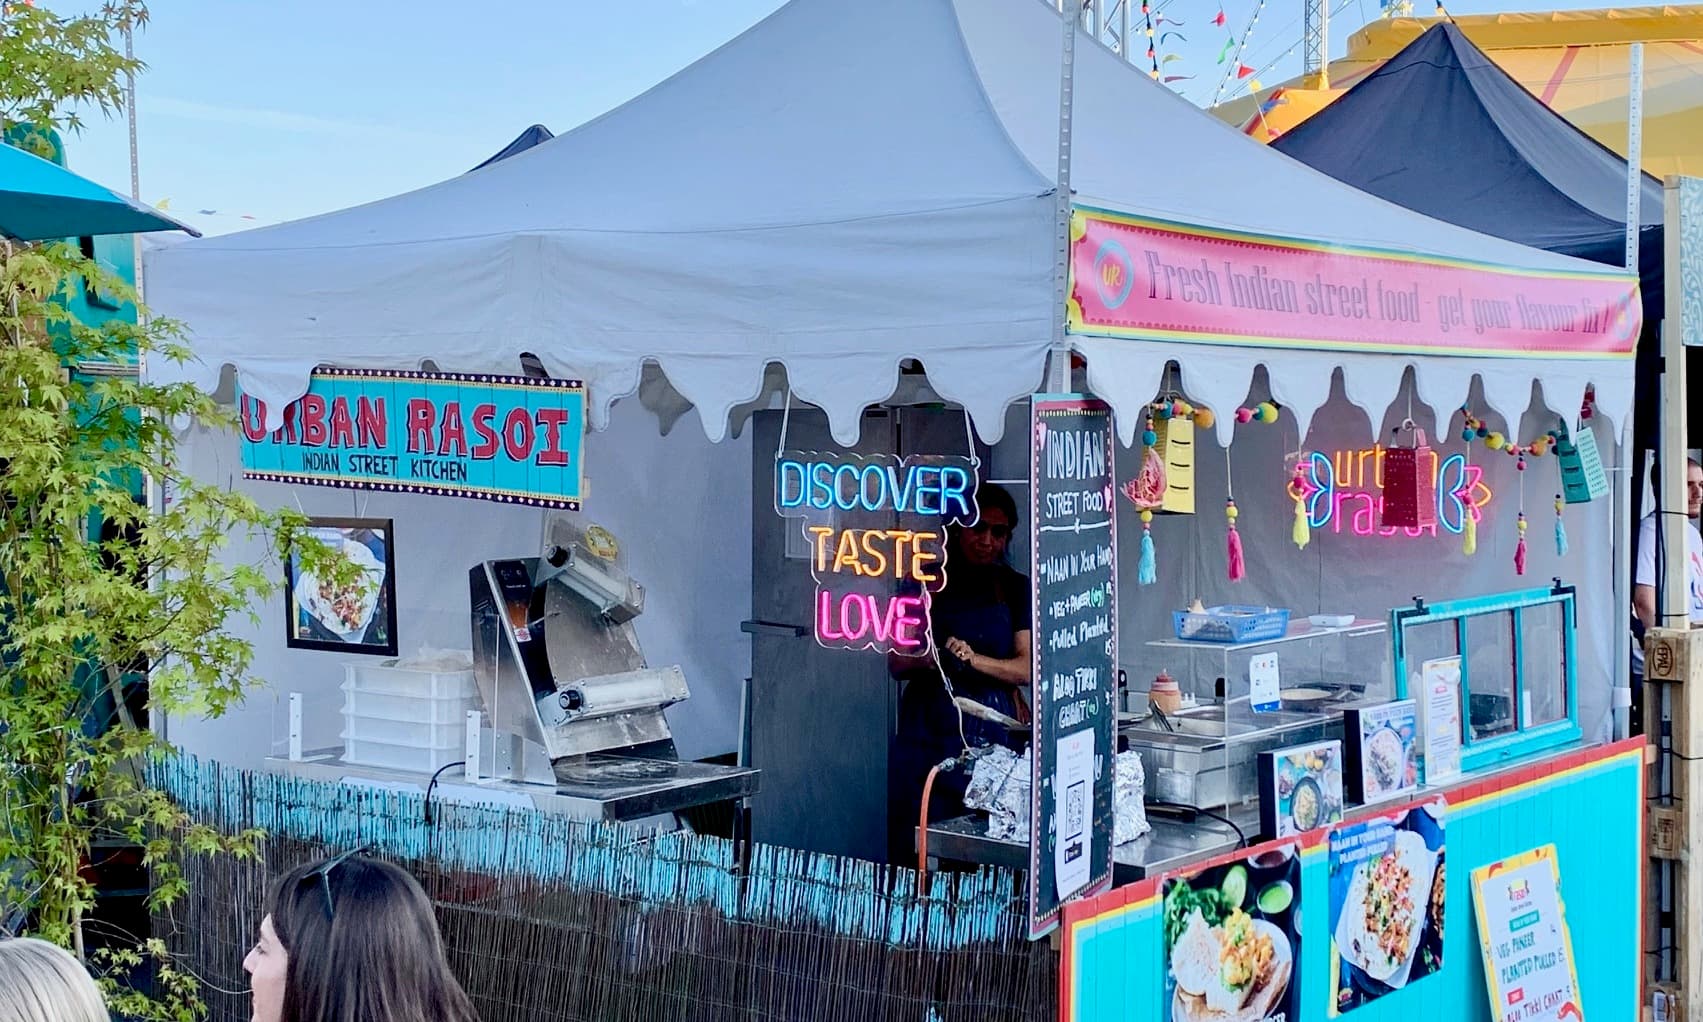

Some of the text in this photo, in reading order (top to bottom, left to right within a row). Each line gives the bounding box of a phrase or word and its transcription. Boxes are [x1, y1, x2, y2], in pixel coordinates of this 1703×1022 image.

[1144, 250, 1222, 306] Fresh
[1224, 261, 1300, 314] Indian
[1304, 273, 1371, 319] street
[1376, 279, 1421, 322] food
[1437, 287, 1467, 333] get
[1471, 298, 1512, 335] your
[1516, 293, 1578, 332] flavour
[401, 398, 569, 467] RASOI
[1046, 429, 1106, 481] INDIAN
[302, 452, 468, 482] INDIAN STREET KITCHEN
[779, 461, 970, 516] DISCOVER
[1045, 490, 1104, 519] STREET FOOD
[808, 526, 938, 582] TASTE
[1046, 555, 1069, 585] NAAN
[821, 590, 921, 646] LOVE
[1053, 625, 1078, 653] Pulled
